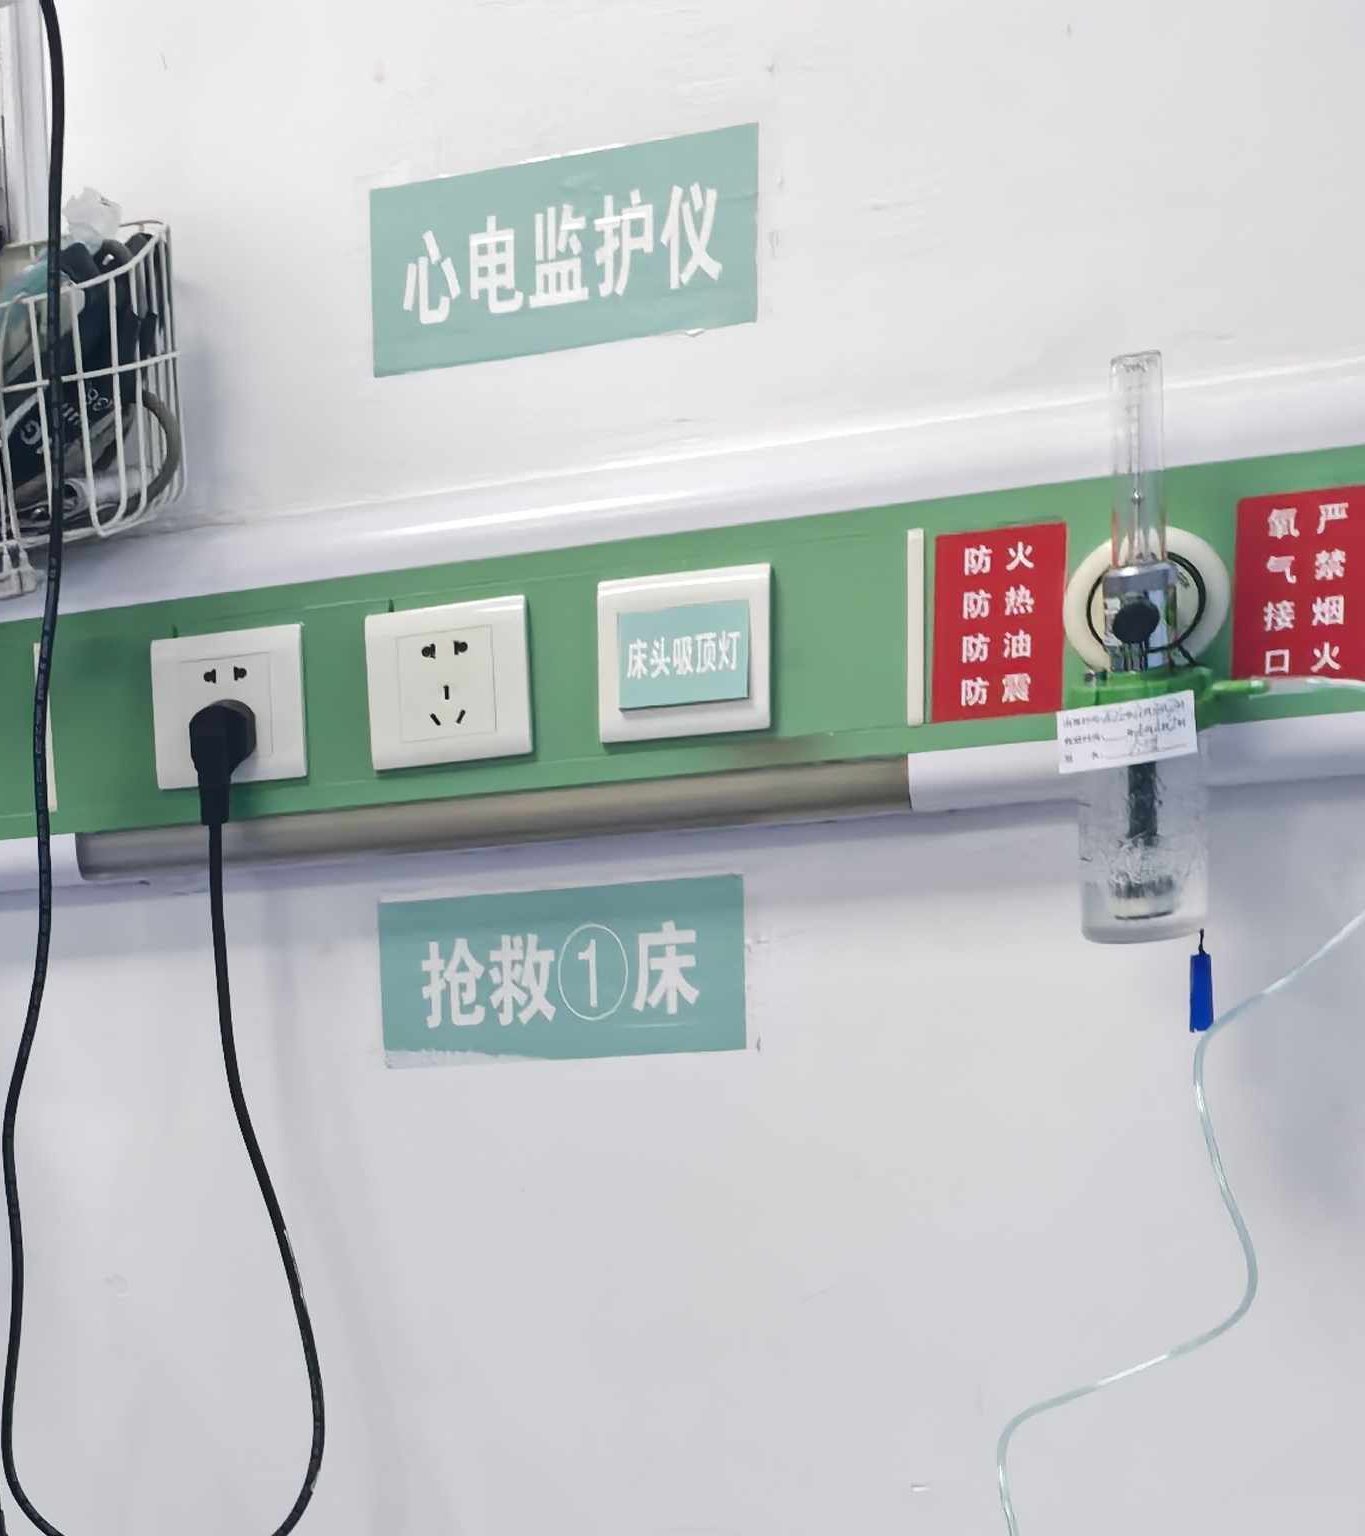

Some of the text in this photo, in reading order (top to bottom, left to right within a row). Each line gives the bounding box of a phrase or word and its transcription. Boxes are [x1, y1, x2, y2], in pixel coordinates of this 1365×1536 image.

[403, 182, 723, 325] 心电监护仪
[963, 541, 1035, 576] 防火
[962, 583, 1036, 620] 防热
[1263, 507, 1301, 675] 氧气接口
[1310, 502, 1349, 673] 严禁烟火
[627, 630, 741, 679] 床头吸顶灯
[961, 629, 1033, 664] 防油
[960, 673, 1032, 707] 防震
